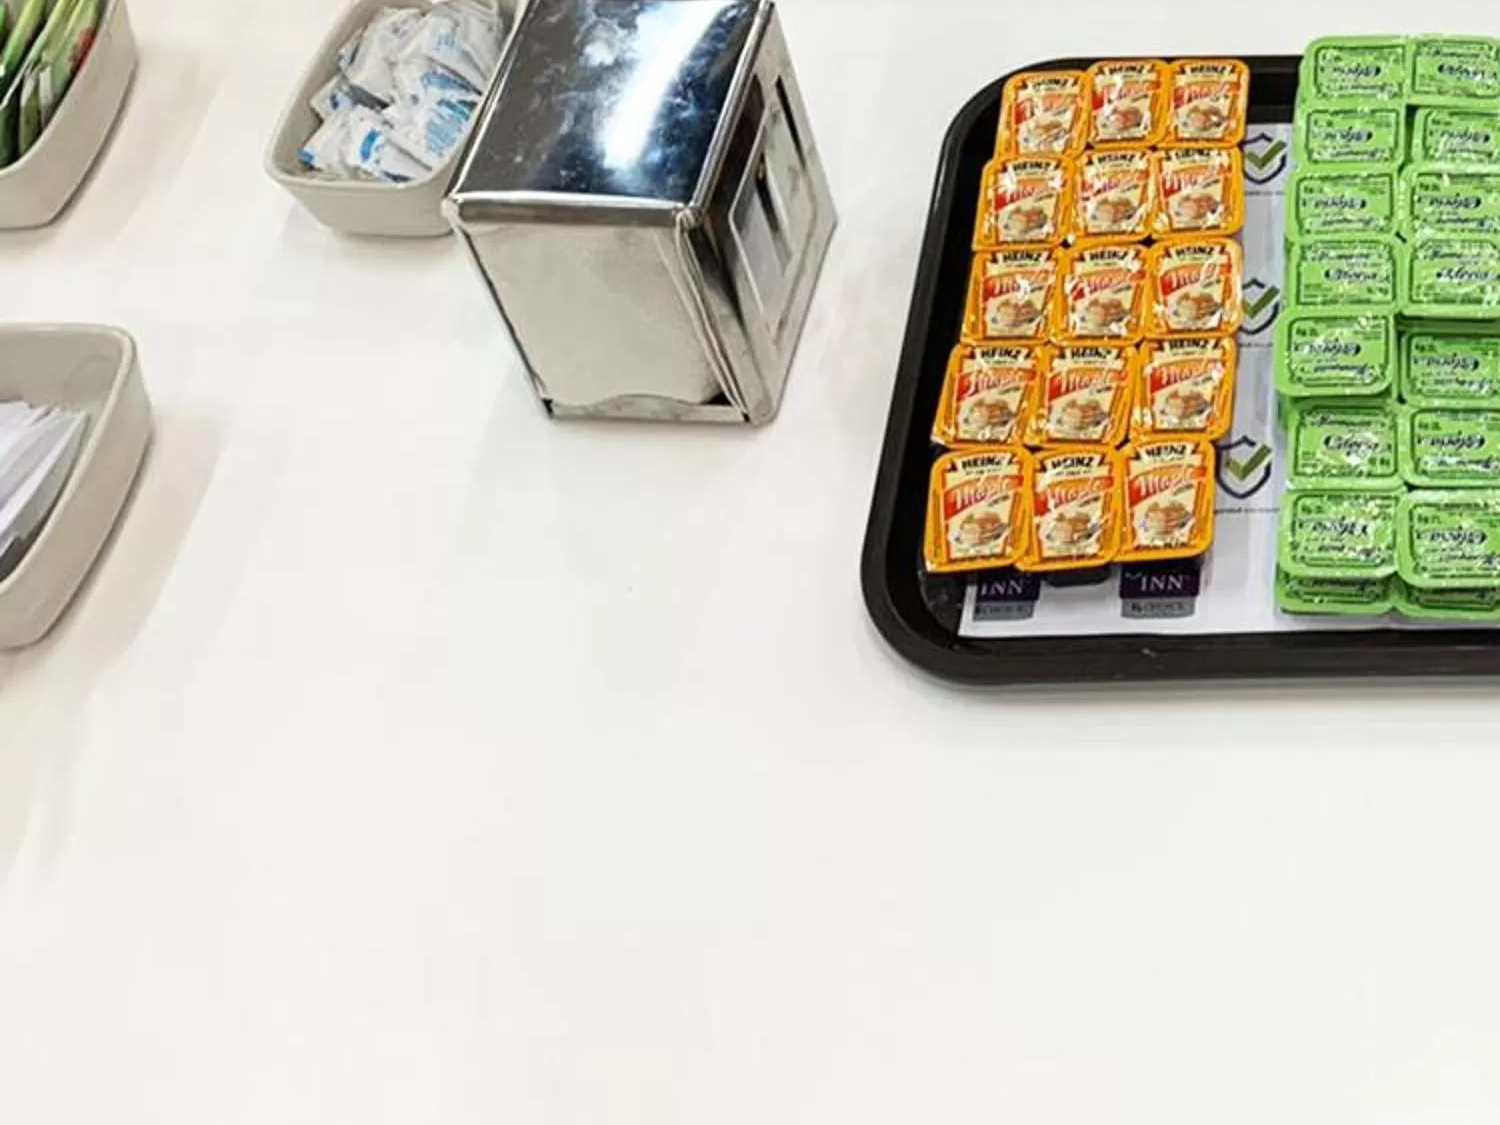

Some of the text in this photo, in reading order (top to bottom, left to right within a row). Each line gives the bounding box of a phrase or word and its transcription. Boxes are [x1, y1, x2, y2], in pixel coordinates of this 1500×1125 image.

[1168, 339, 1208, 351] HEINZ
[980, 346, 1021, 359] HEINZ
[1070, 346, 1112, 359] HEINZ
[1145, 443, 1188, 457] HEINZ
[961, 455, 1008, 469] HEINZ
[1051, 455, 1095, 469] HEINZ
[1140, 574, 1183, 592] INN
